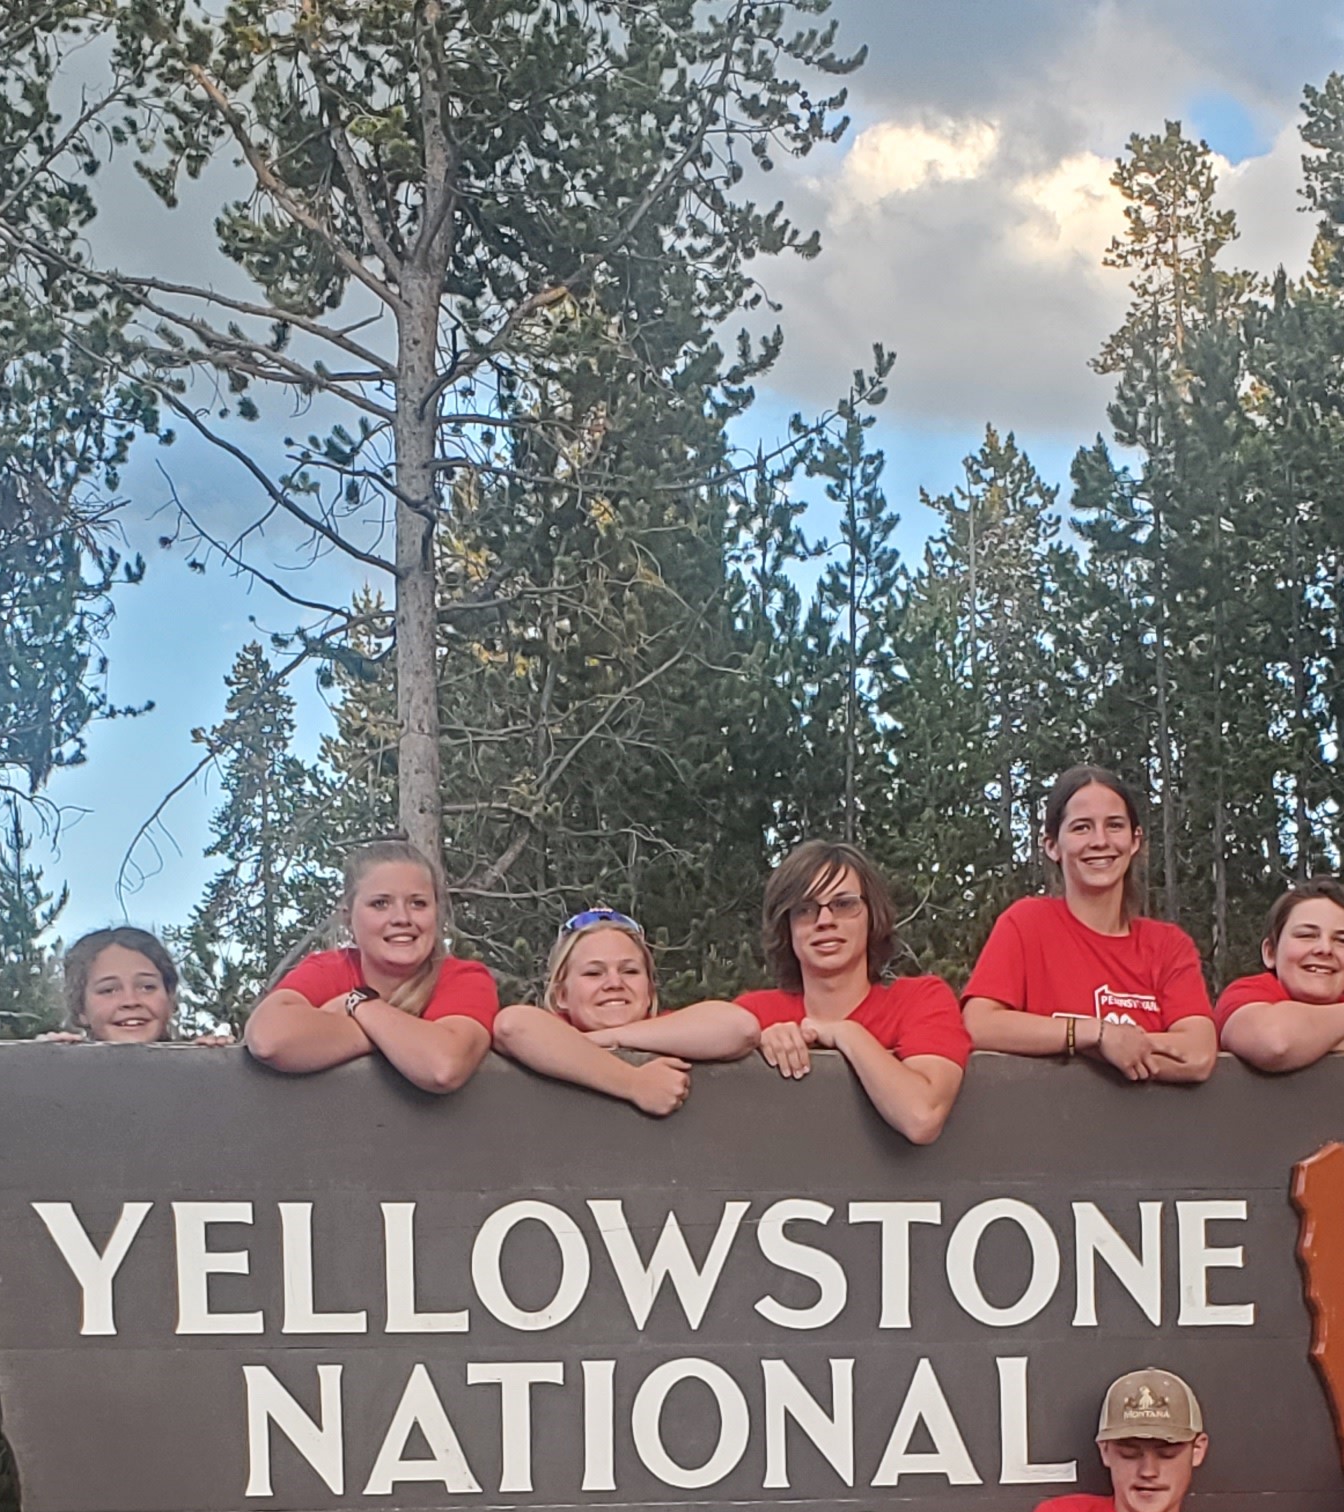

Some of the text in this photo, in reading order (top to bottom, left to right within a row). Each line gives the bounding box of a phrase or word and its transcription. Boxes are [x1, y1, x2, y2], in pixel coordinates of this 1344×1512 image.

[31, 1198, 1254, 1335] YELLOWSTONE
[243, 1357, 1076, 1496] NATIONAL
[1123, 1410, 1170, 1420] MONTANA
